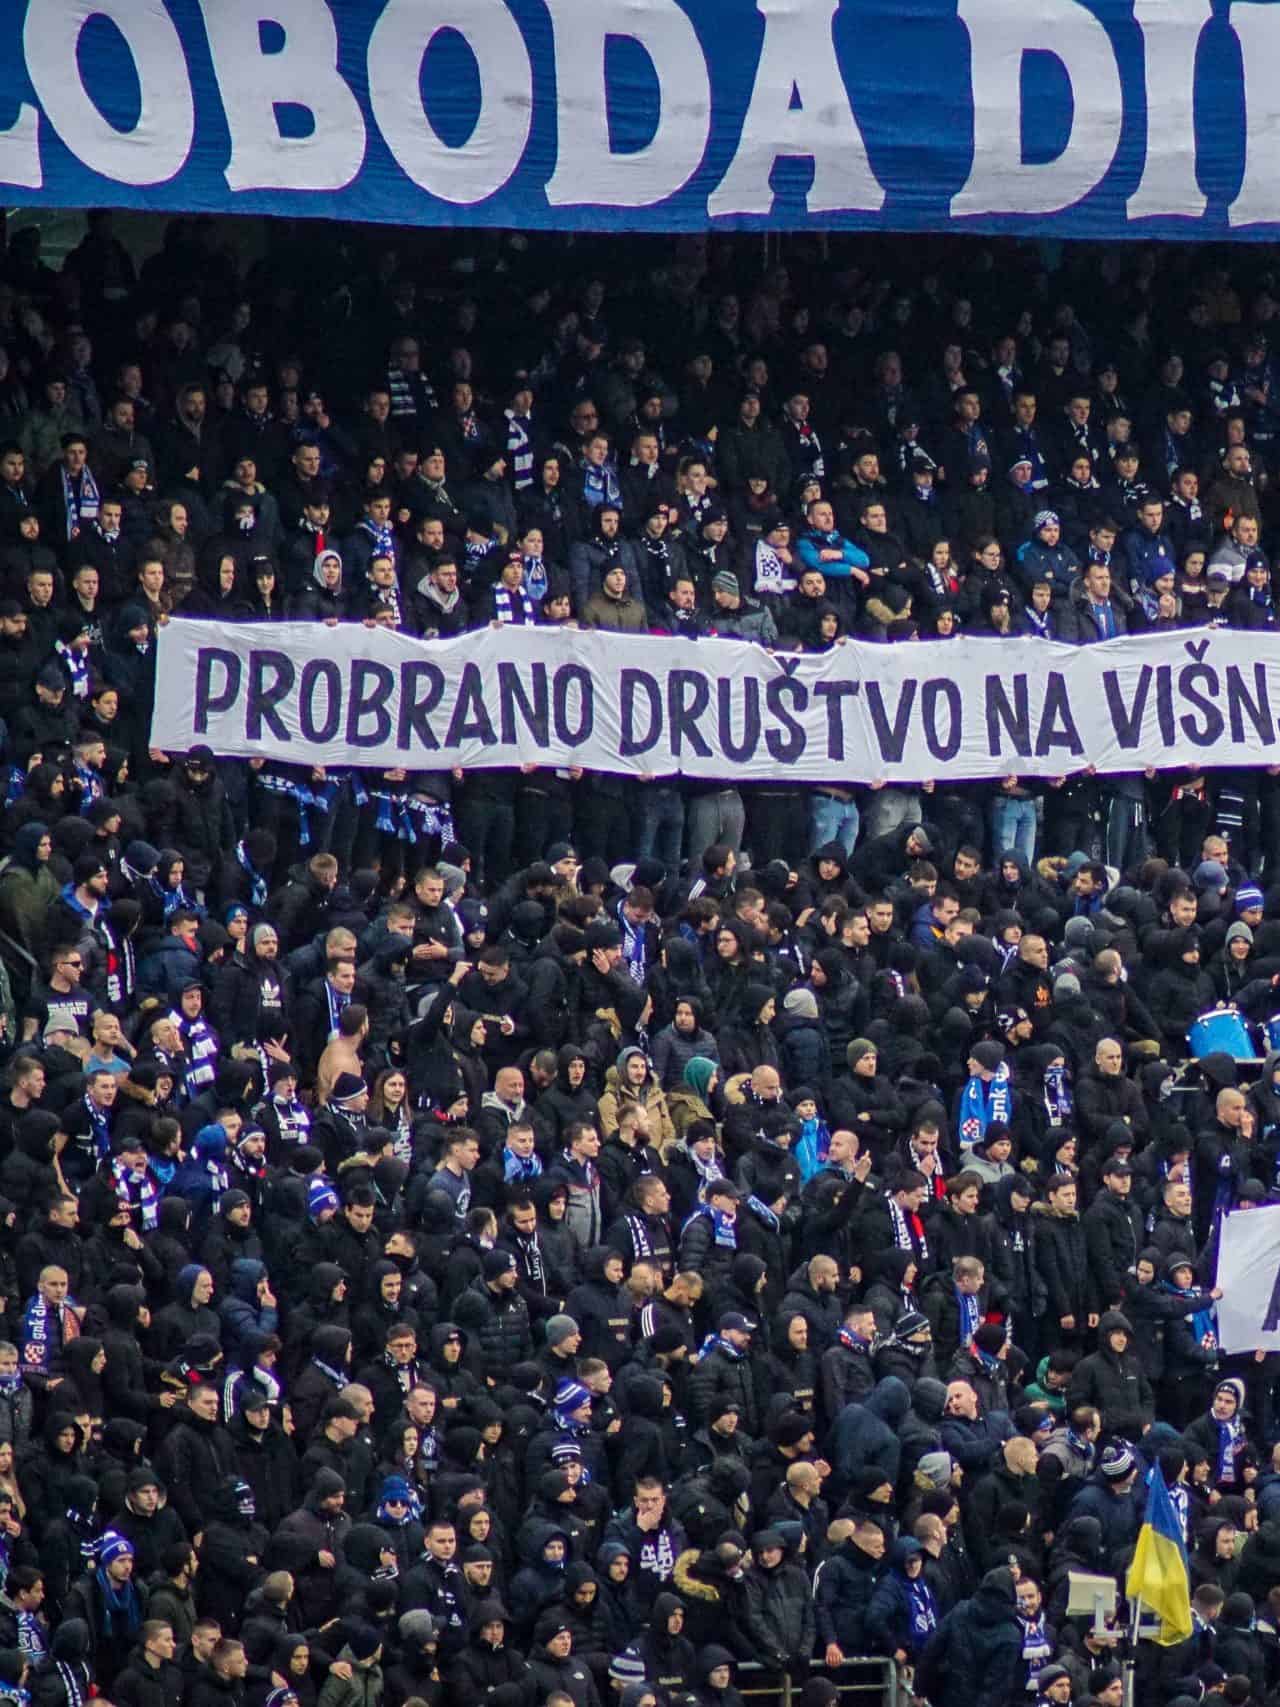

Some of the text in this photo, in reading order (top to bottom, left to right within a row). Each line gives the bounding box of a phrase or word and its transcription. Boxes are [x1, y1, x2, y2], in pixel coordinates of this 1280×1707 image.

[193, 647, 593, 749] PROBRANO
[619, 656, 961, 763] DRUŠTVO
[985, 671, 1084, 756] NA
